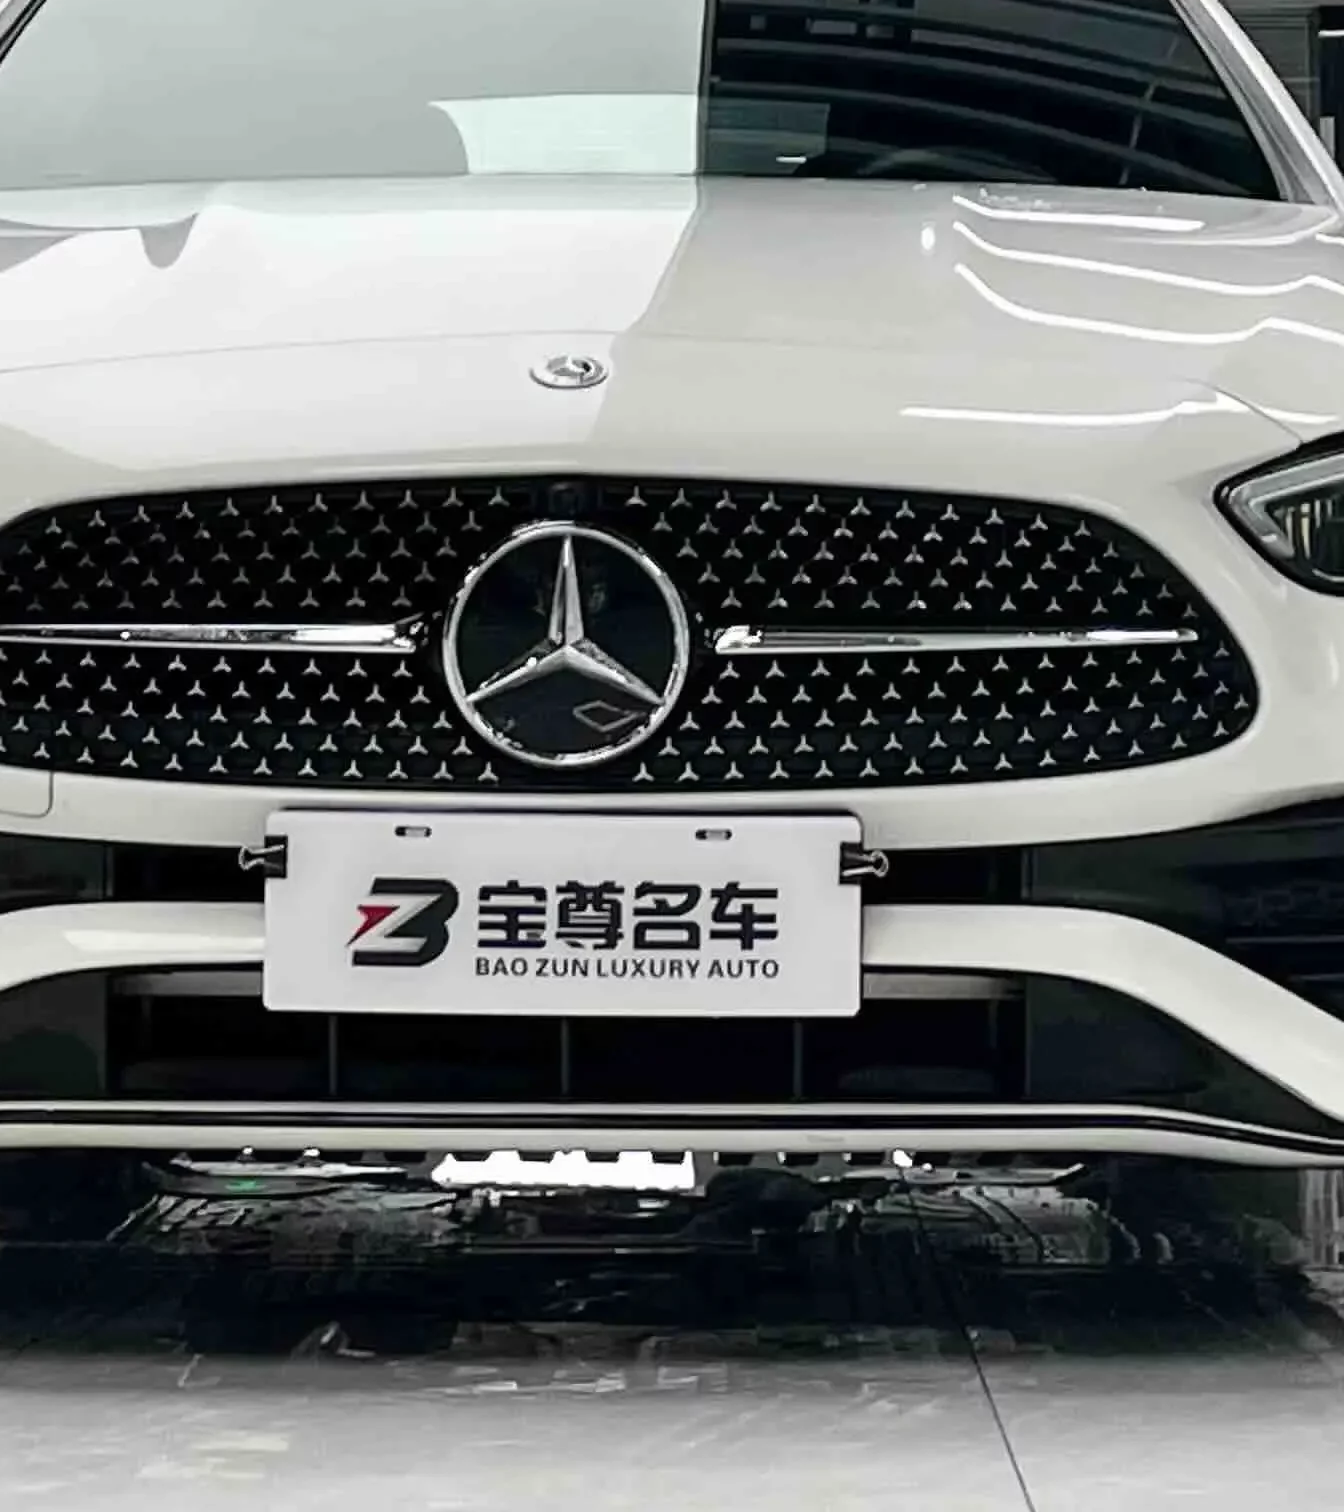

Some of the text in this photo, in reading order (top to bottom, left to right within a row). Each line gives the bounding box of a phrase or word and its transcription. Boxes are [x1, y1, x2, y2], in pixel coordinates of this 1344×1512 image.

[476, 879, 779, 951] 宝尊名车
[475, 957, 779, 979] BAO ZUN LUXURY AUTO
